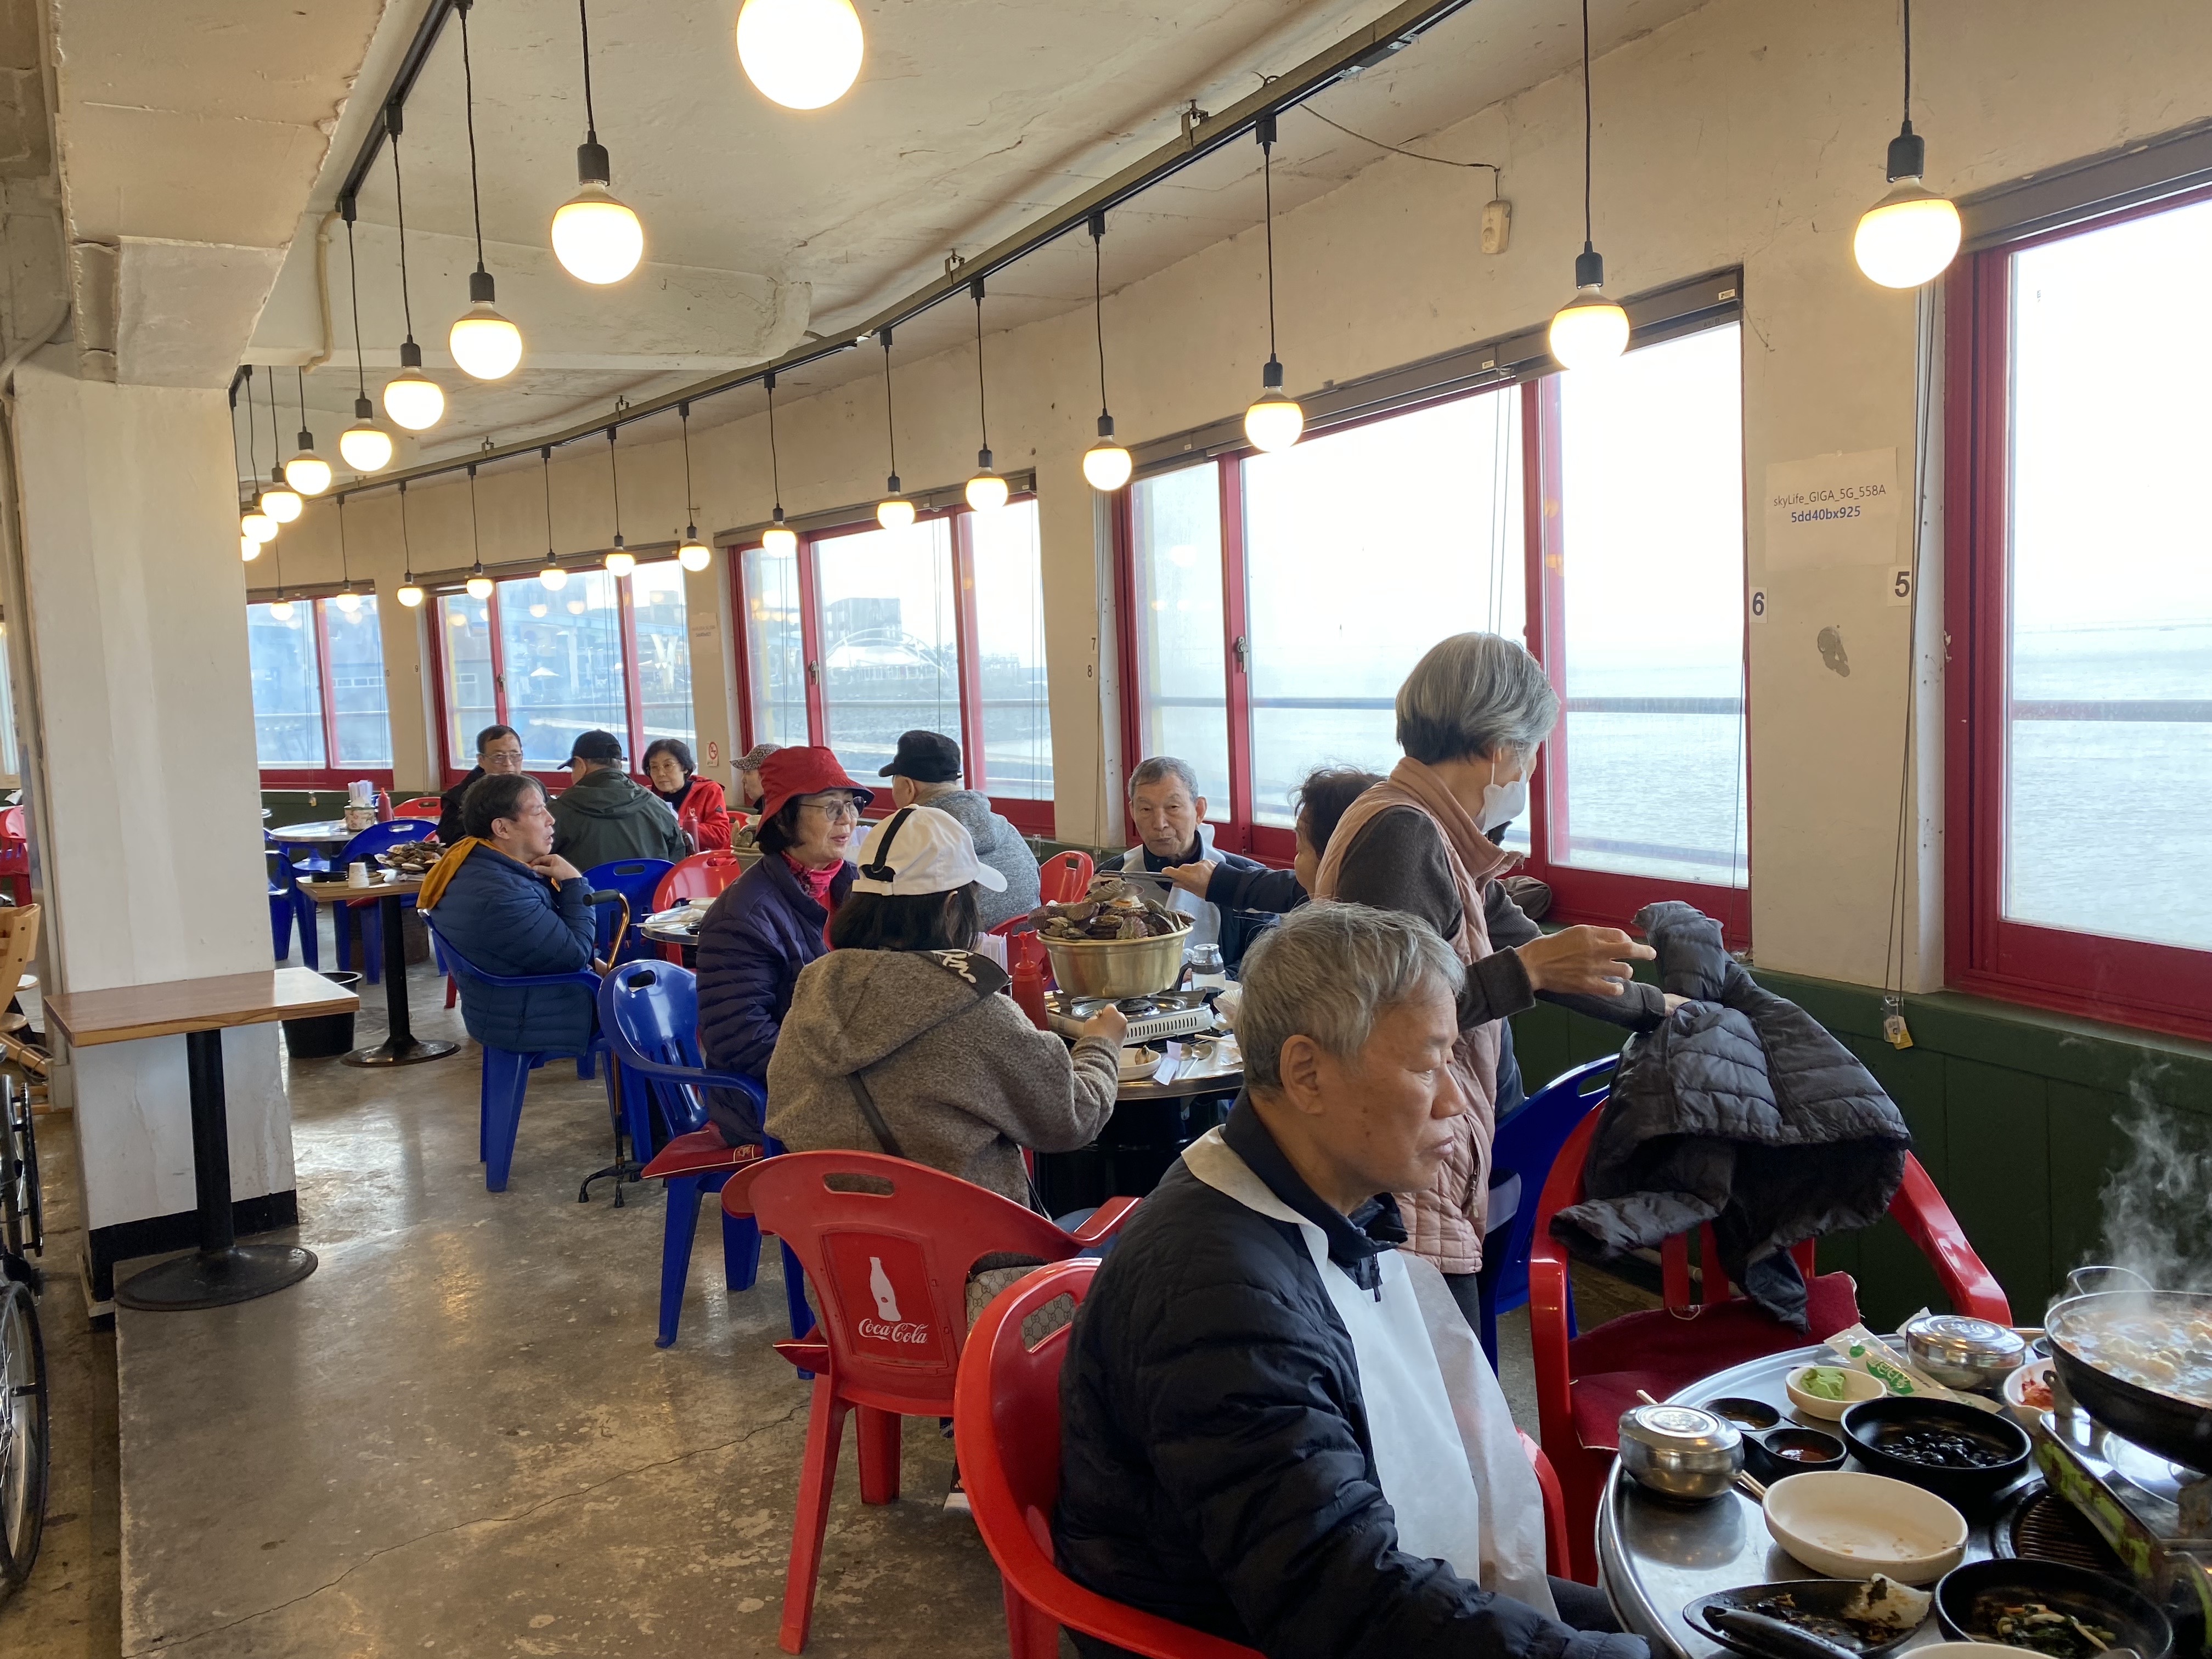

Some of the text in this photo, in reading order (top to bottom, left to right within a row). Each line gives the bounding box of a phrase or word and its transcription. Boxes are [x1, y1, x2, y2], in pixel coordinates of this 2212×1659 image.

[1774, 484, 1886, 508] skyLife_GIGA_5G_558A
[1791, 506, 1861, 522] 5dd40bx925
[1895, 571, 1910, 597] 5
[1752, 592, 1764, 616] 6
[1091, 637, 1096, 651] 7
[1087, 664, 1092, 678] 8
